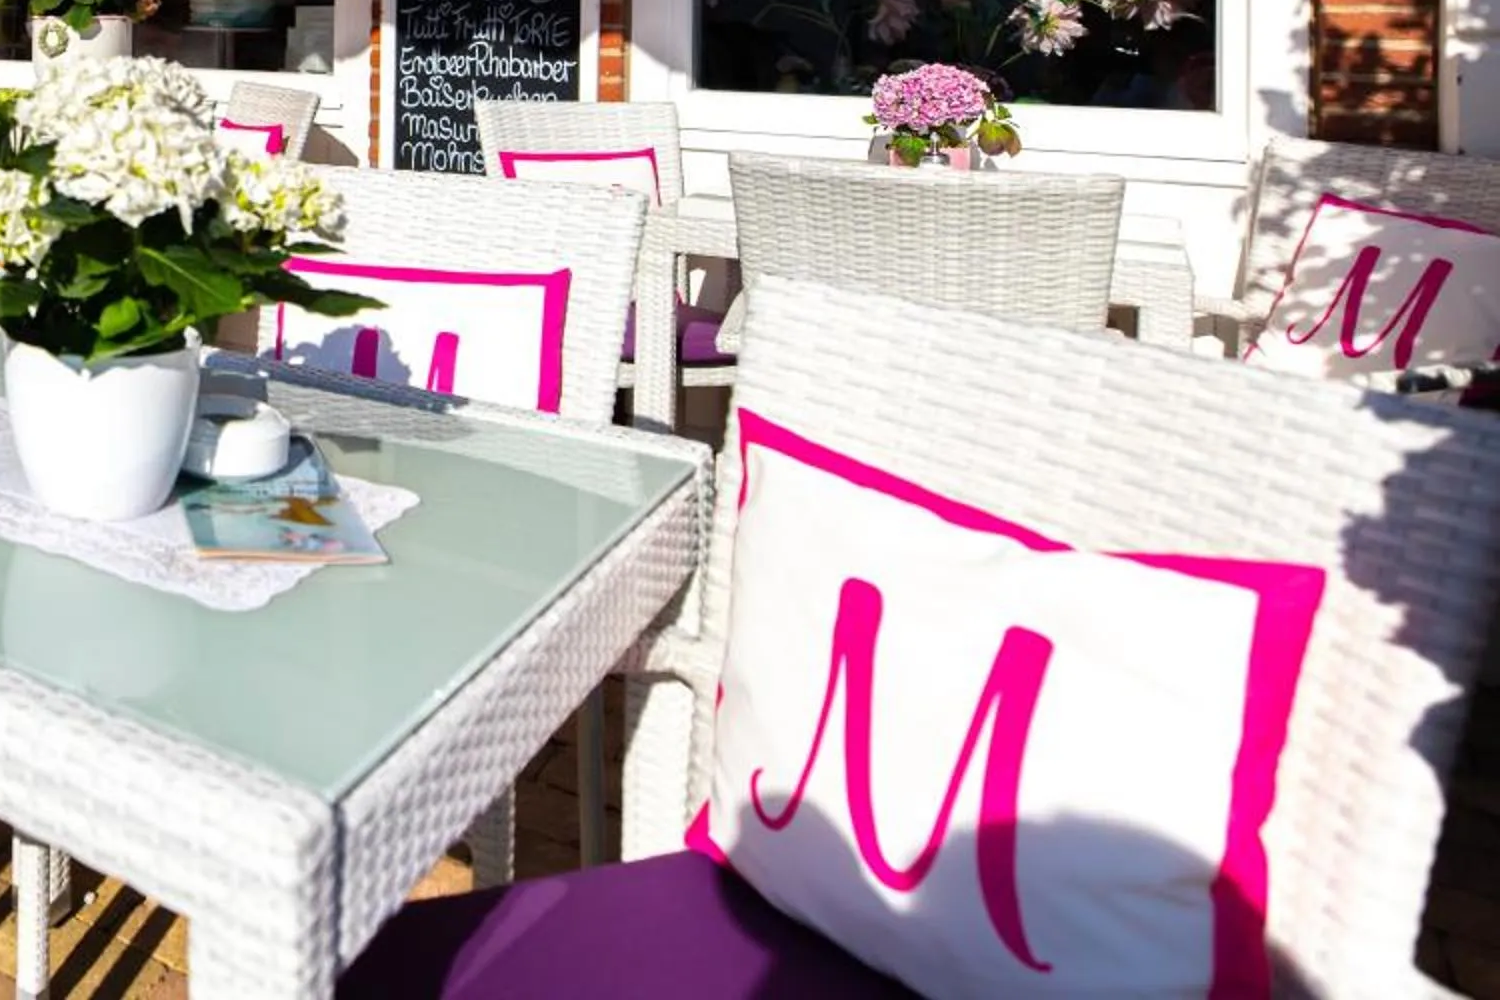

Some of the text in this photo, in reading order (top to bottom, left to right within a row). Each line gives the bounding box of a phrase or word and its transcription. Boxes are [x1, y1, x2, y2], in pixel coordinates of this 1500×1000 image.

[401, 2, 452, 40] Tutti
[452, 3, 514, 42] Frutti
[402, 113, 480, 143] Masur
[402, 141, 486, 172] Mohns
[751, 577, 1054, 973] M
